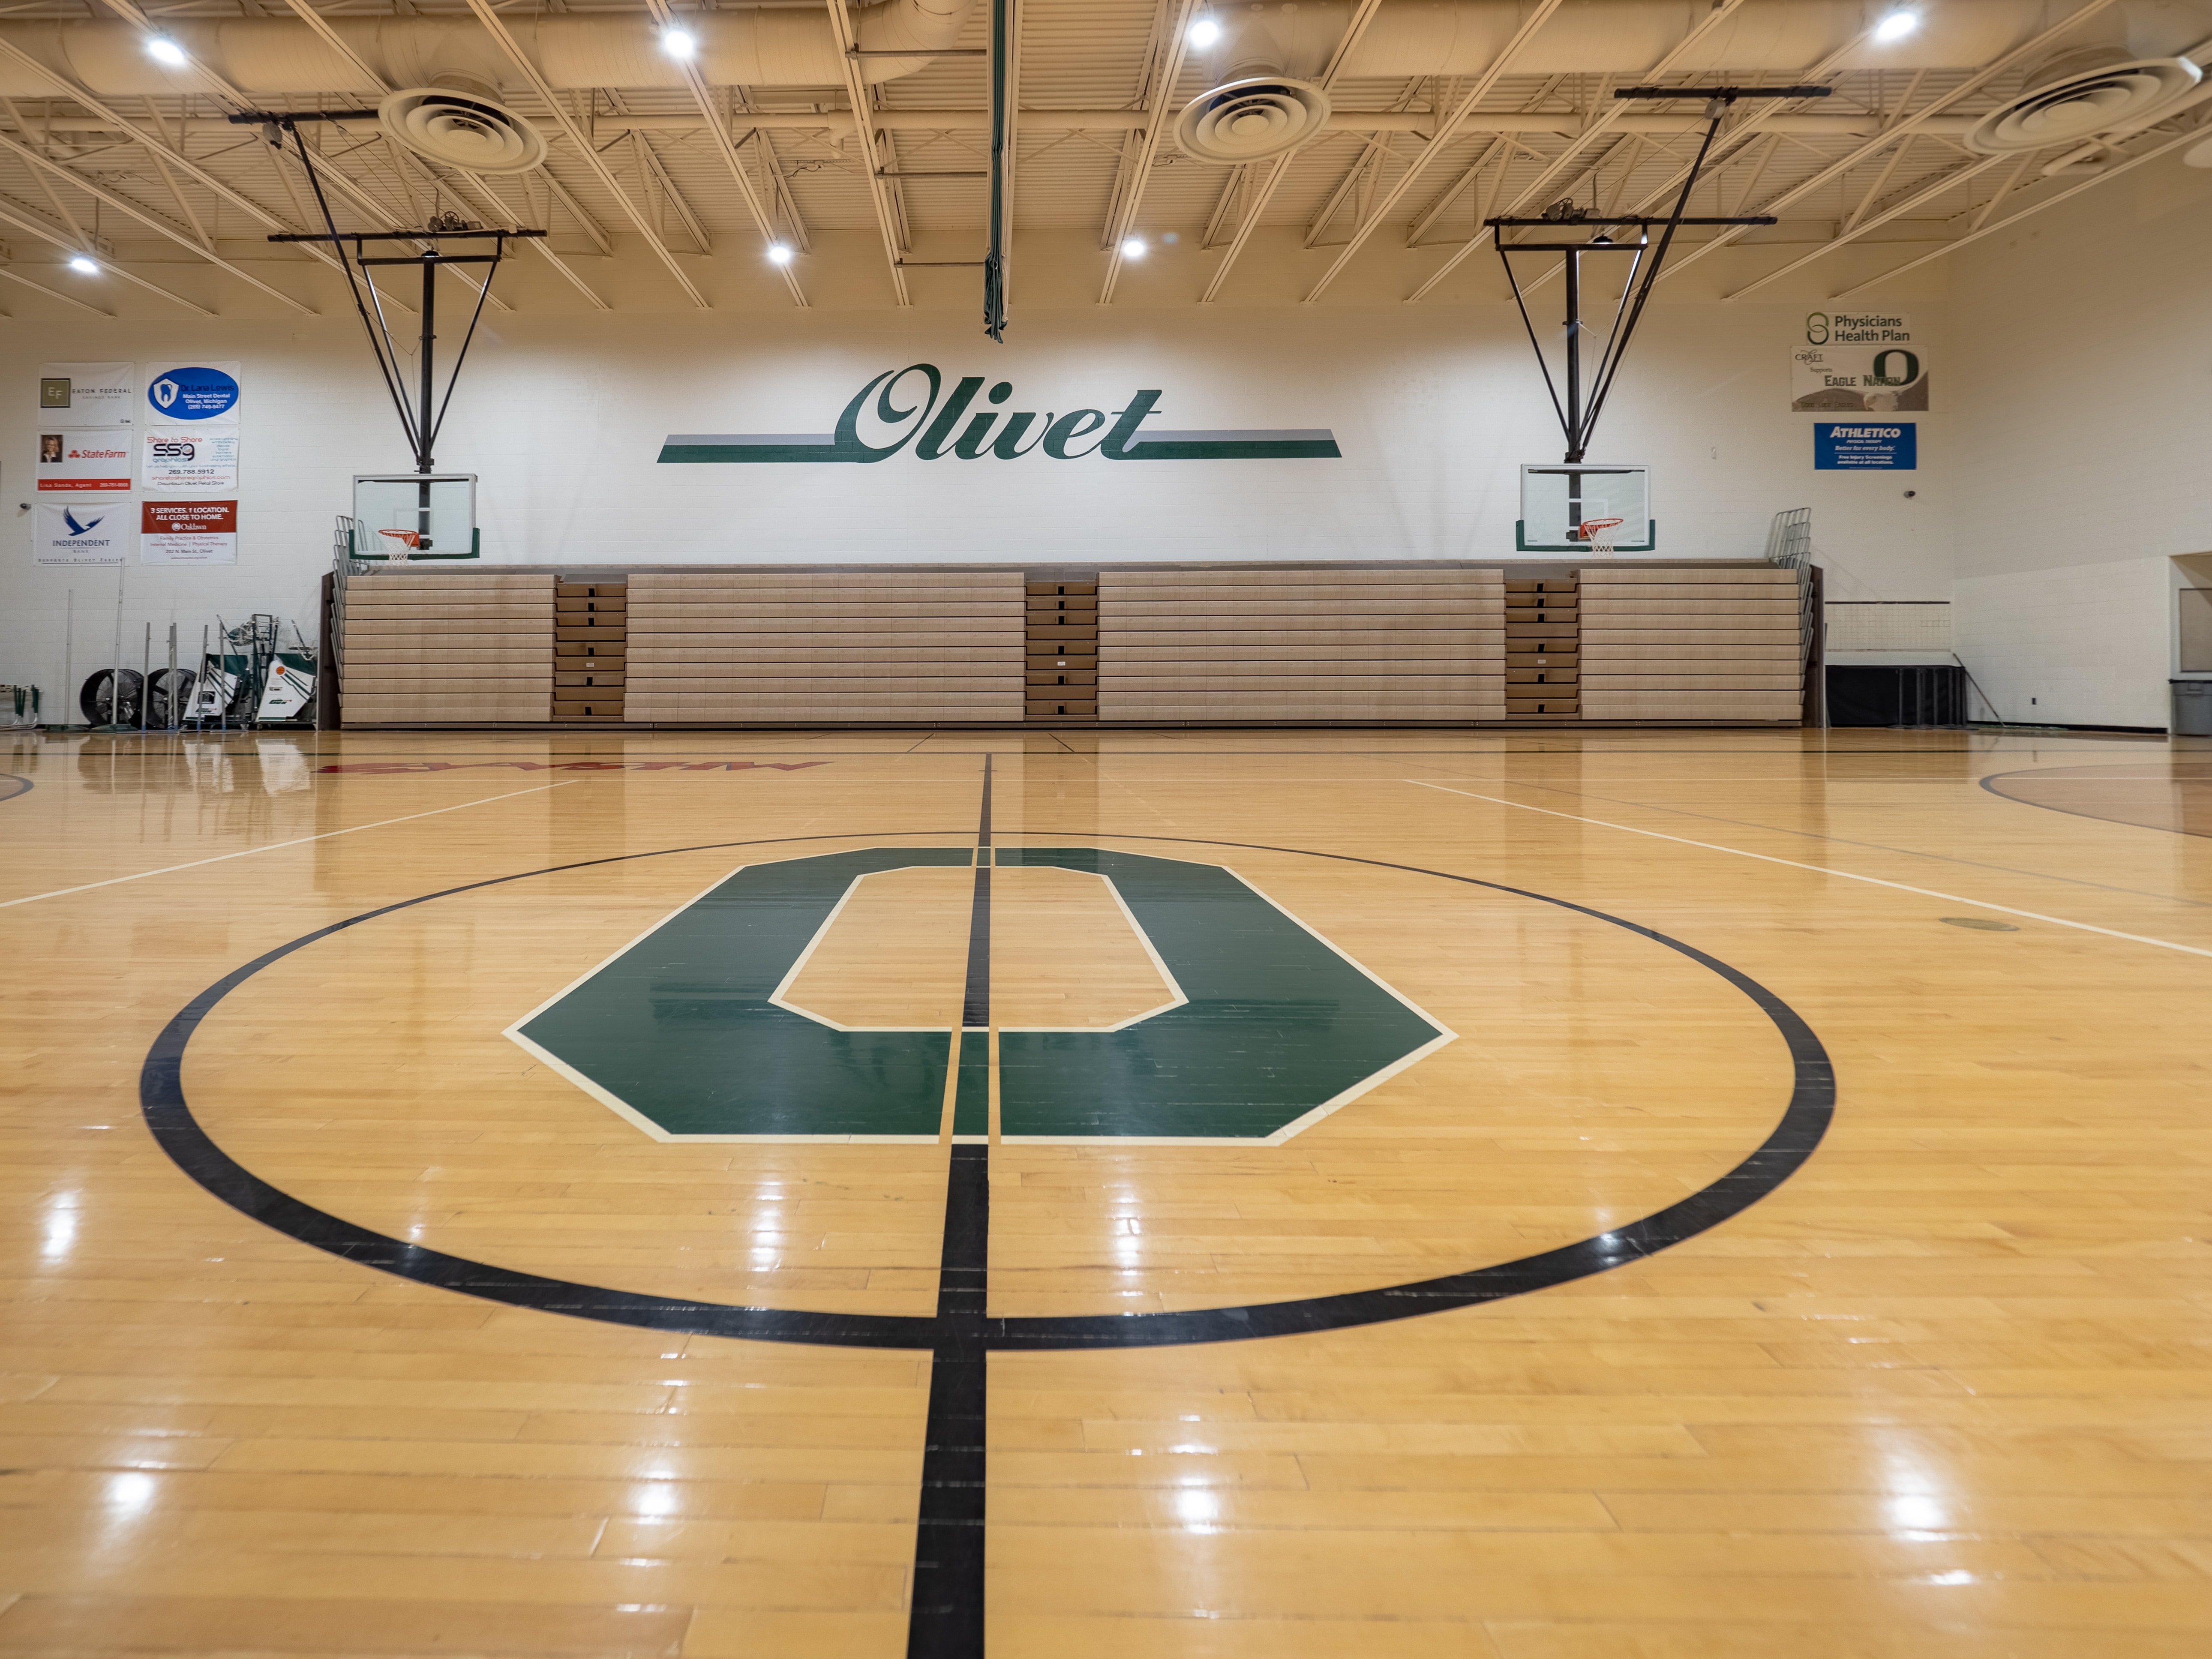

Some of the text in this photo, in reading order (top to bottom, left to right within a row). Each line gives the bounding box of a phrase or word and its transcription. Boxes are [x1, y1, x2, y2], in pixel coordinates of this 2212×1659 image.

[1835, 315, 1902, 330] Physicians
[1835, 330, 1910, 341] Health Plan
[1795, 349, 1823, 365] CRAFT
[48, 387, 63, 399] EF
[835, 363, 1162, 463] Olivet
[1830, 426, 1901, 438] ATHLETICO
